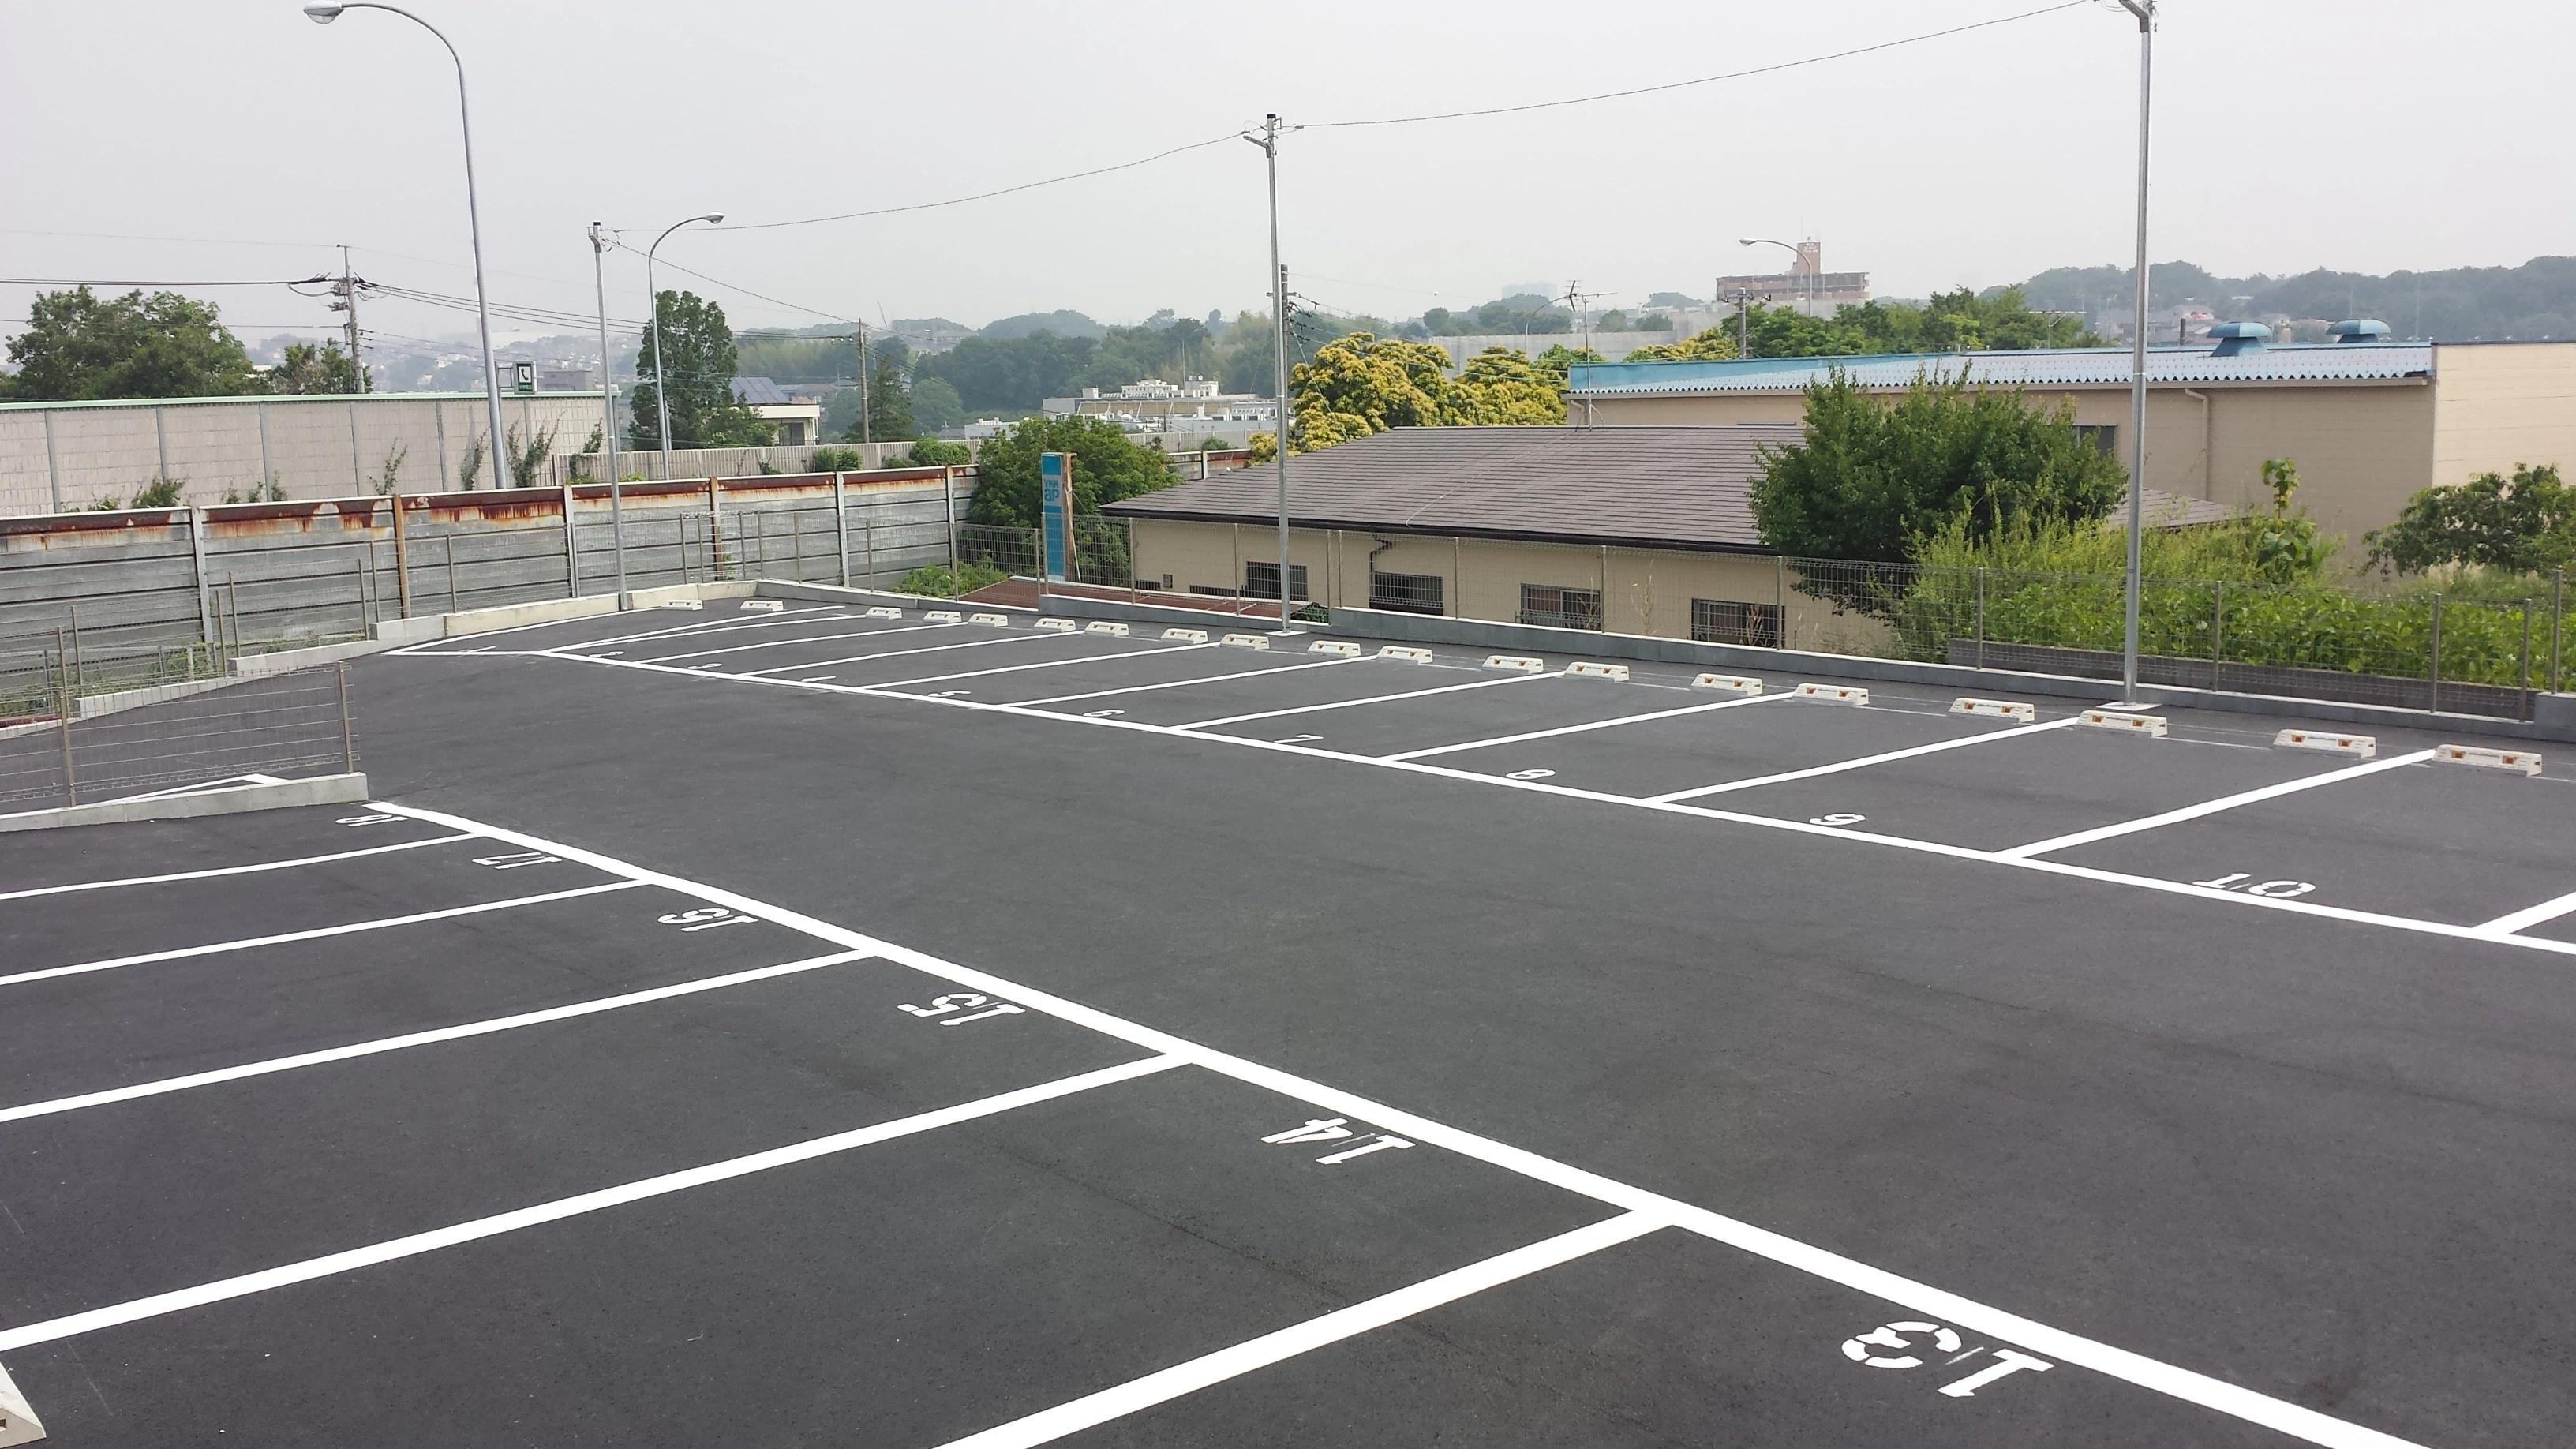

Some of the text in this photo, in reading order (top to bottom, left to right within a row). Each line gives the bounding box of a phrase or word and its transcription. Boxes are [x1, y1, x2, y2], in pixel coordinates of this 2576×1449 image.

[1044, 489, 1059, 502] ap
[1274, 734, 1324, 743] 7
[1505, 769, 1556, 780] 8
[335, 814, 409, 827] 18
[1809, 814, 1866, 826] 9
[471, 852, 563, 870] 17
[2192, 873, 2316, 897] 10
[657, 907, 758, 932] 16
[897, 992, 1026, 1026] 15
[1260, 1118, 1416, 1165] 14
[1841, 1320, 2054, 1398] 13
